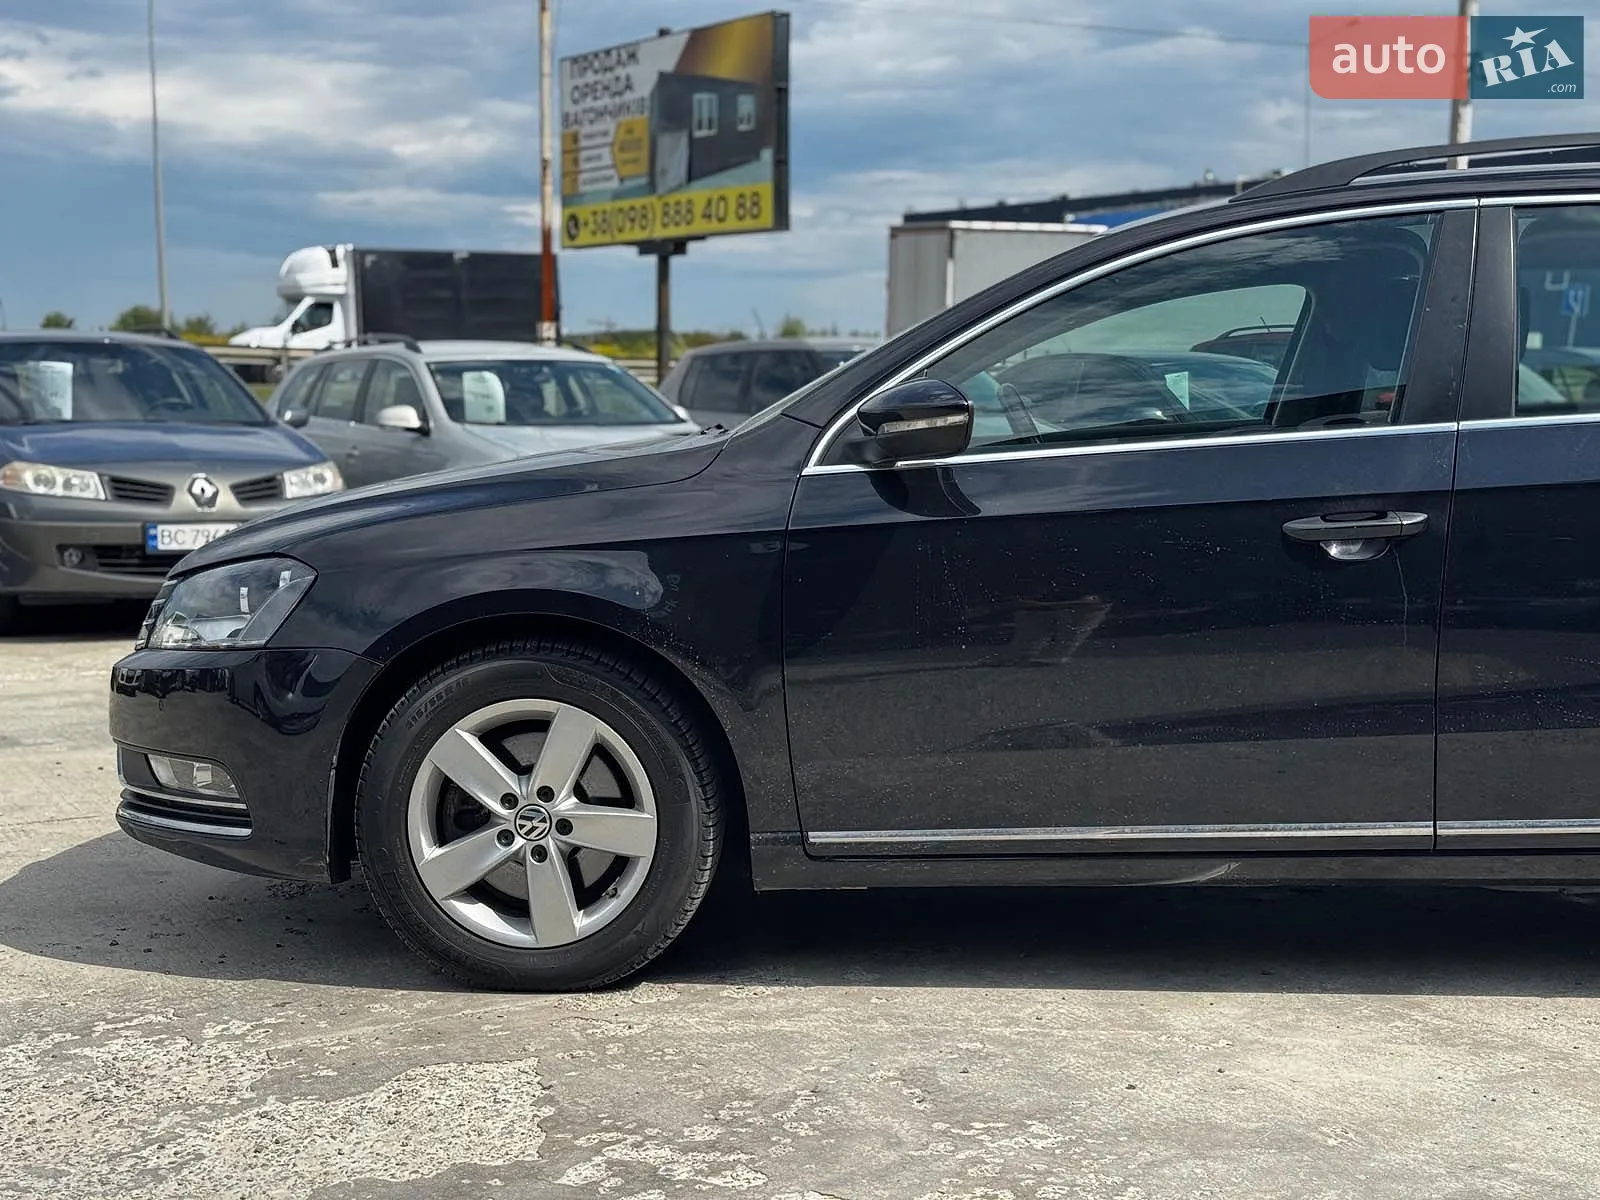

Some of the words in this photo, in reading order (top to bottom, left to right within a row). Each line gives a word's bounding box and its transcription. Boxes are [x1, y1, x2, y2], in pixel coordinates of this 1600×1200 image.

[570, 46, 640, 79] ПРОДАЖ
[570, 73, 635, 105] ОРЕНДА
[660, 199, 695, 229] 888
[702, 195, 729, 224] 40
[735, 191, 762, 221] 88
